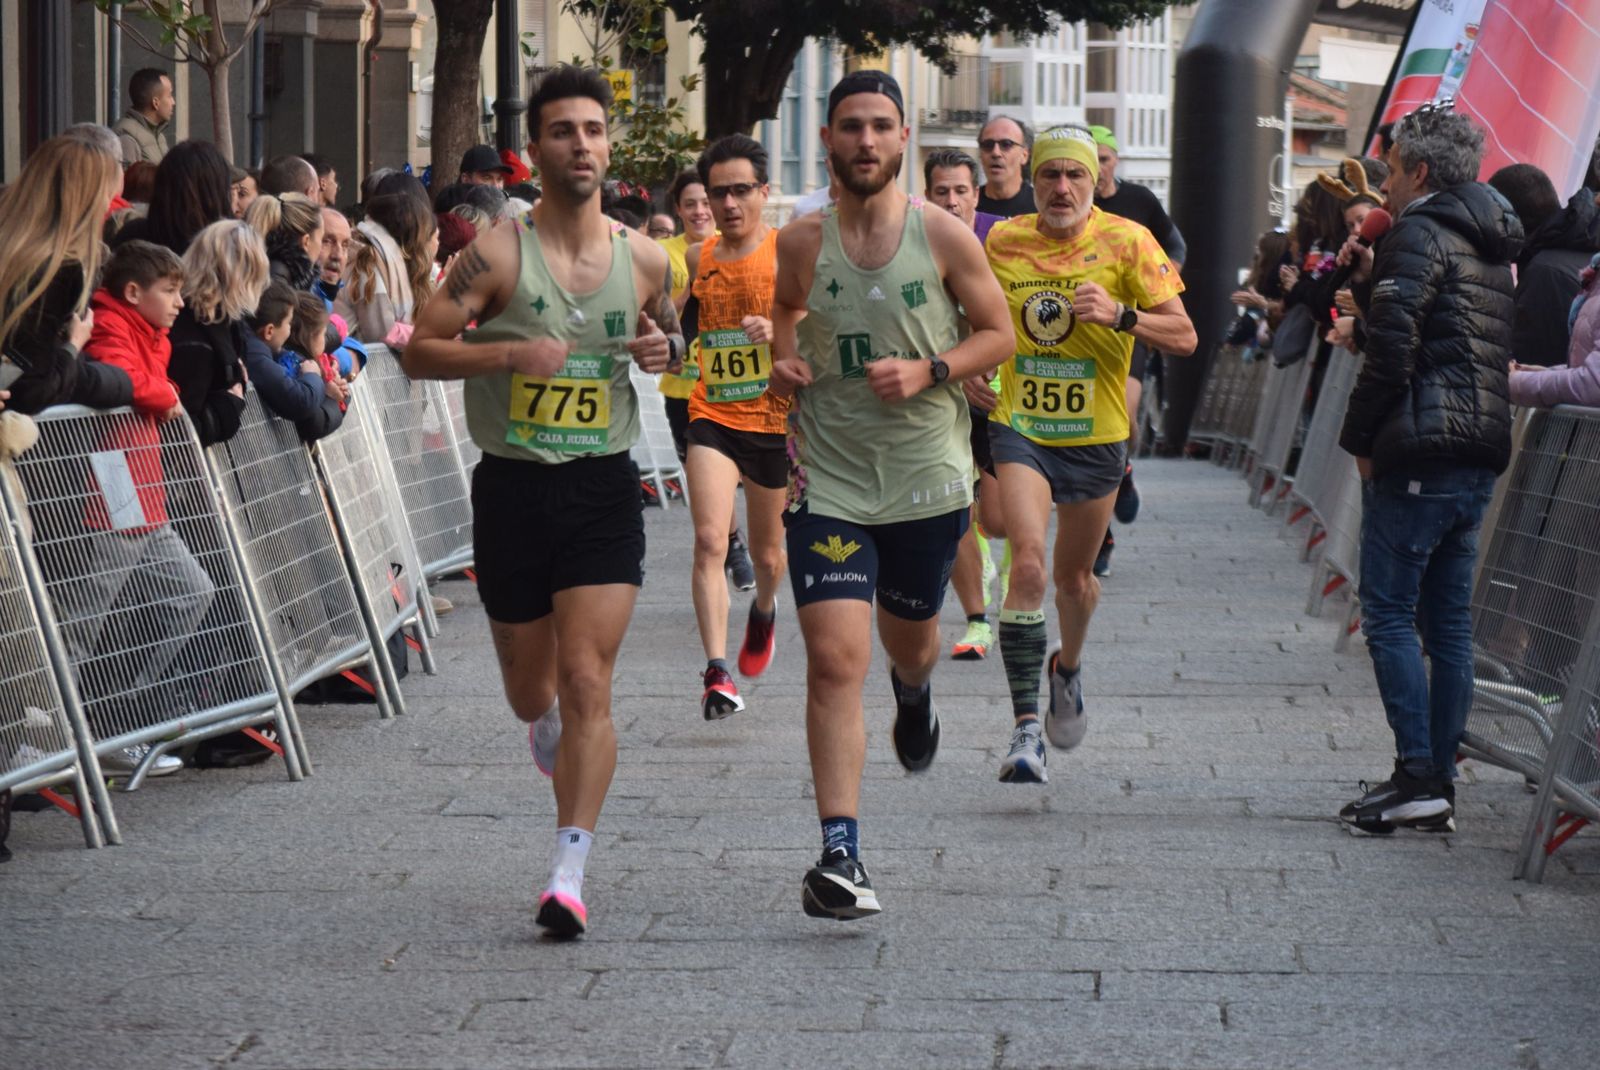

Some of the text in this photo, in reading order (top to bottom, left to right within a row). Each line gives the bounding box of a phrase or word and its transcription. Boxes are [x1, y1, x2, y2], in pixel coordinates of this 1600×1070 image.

[567, 359, 601, 369] DACION
[711, 348, 760, 379] 461
[1036, 369, 1057, 377] CAJA
[1057, 370, 1085, 378] RURAL
[523, 382, 598, 423] 775
[1022, 379, 1085, 413] 356
[1034, 422, 1089, 433] CAJA RURAL
[537, 432, 602, 445] CAJA RURAL
